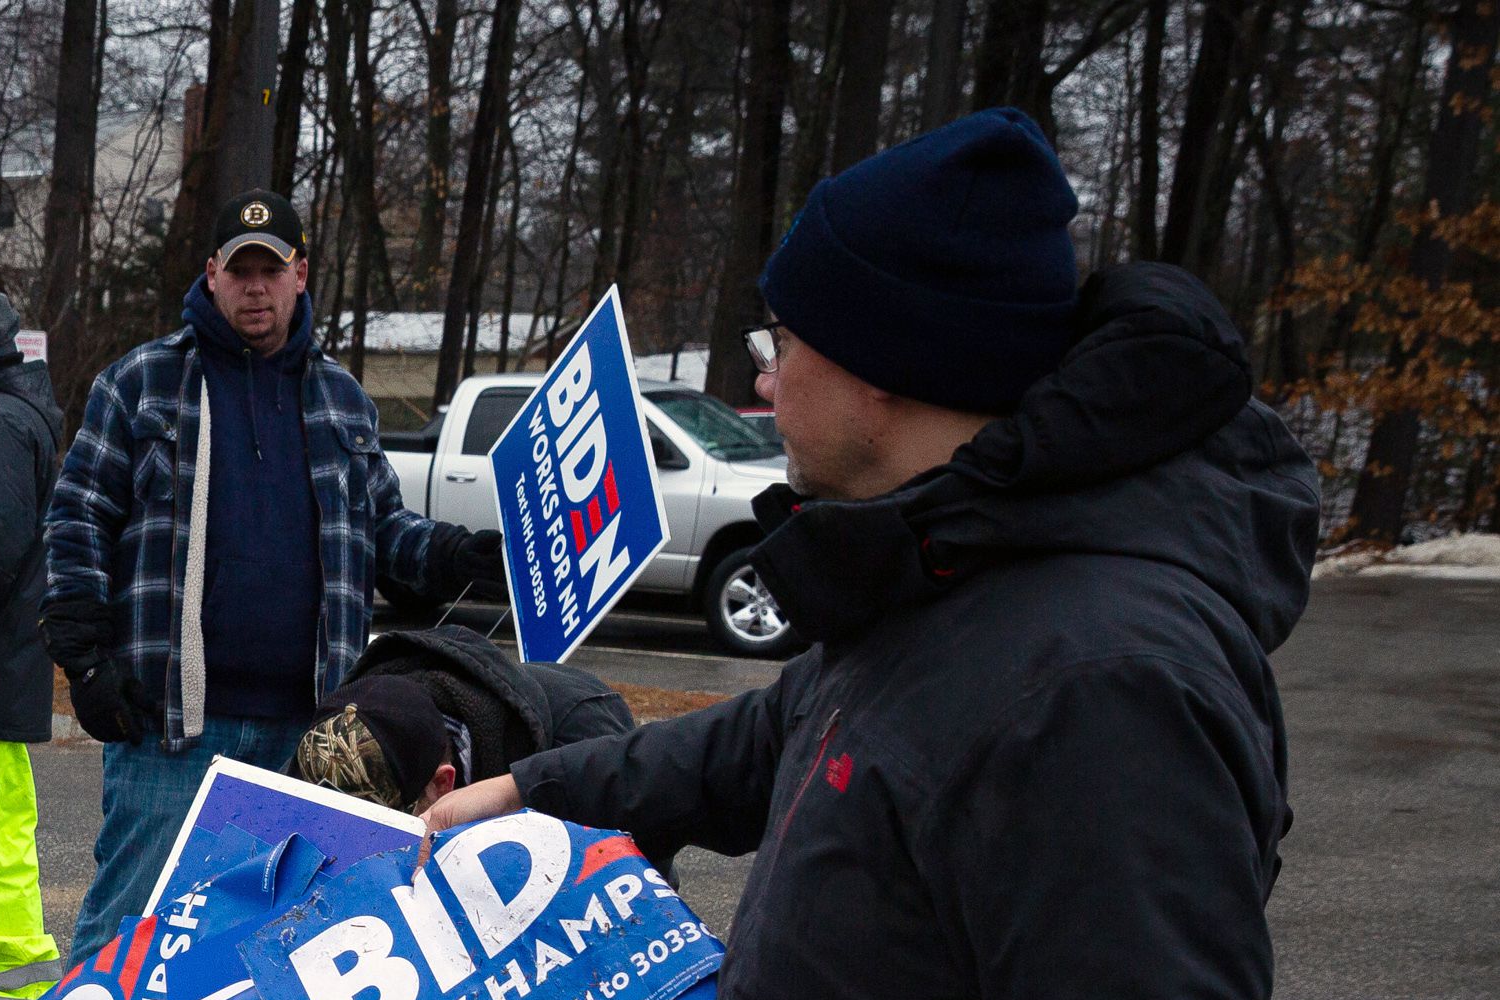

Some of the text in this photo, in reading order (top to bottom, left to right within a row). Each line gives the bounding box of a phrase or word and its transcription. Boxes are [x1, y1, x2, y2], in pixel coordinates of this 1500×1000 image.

[515, 472, 547, 618] Text NH to 30330
[528, 401, 581, 639] WORKS FOR NH
[546, 341, 631, 613] BIDEN
[599, 971, 630, 999] to
